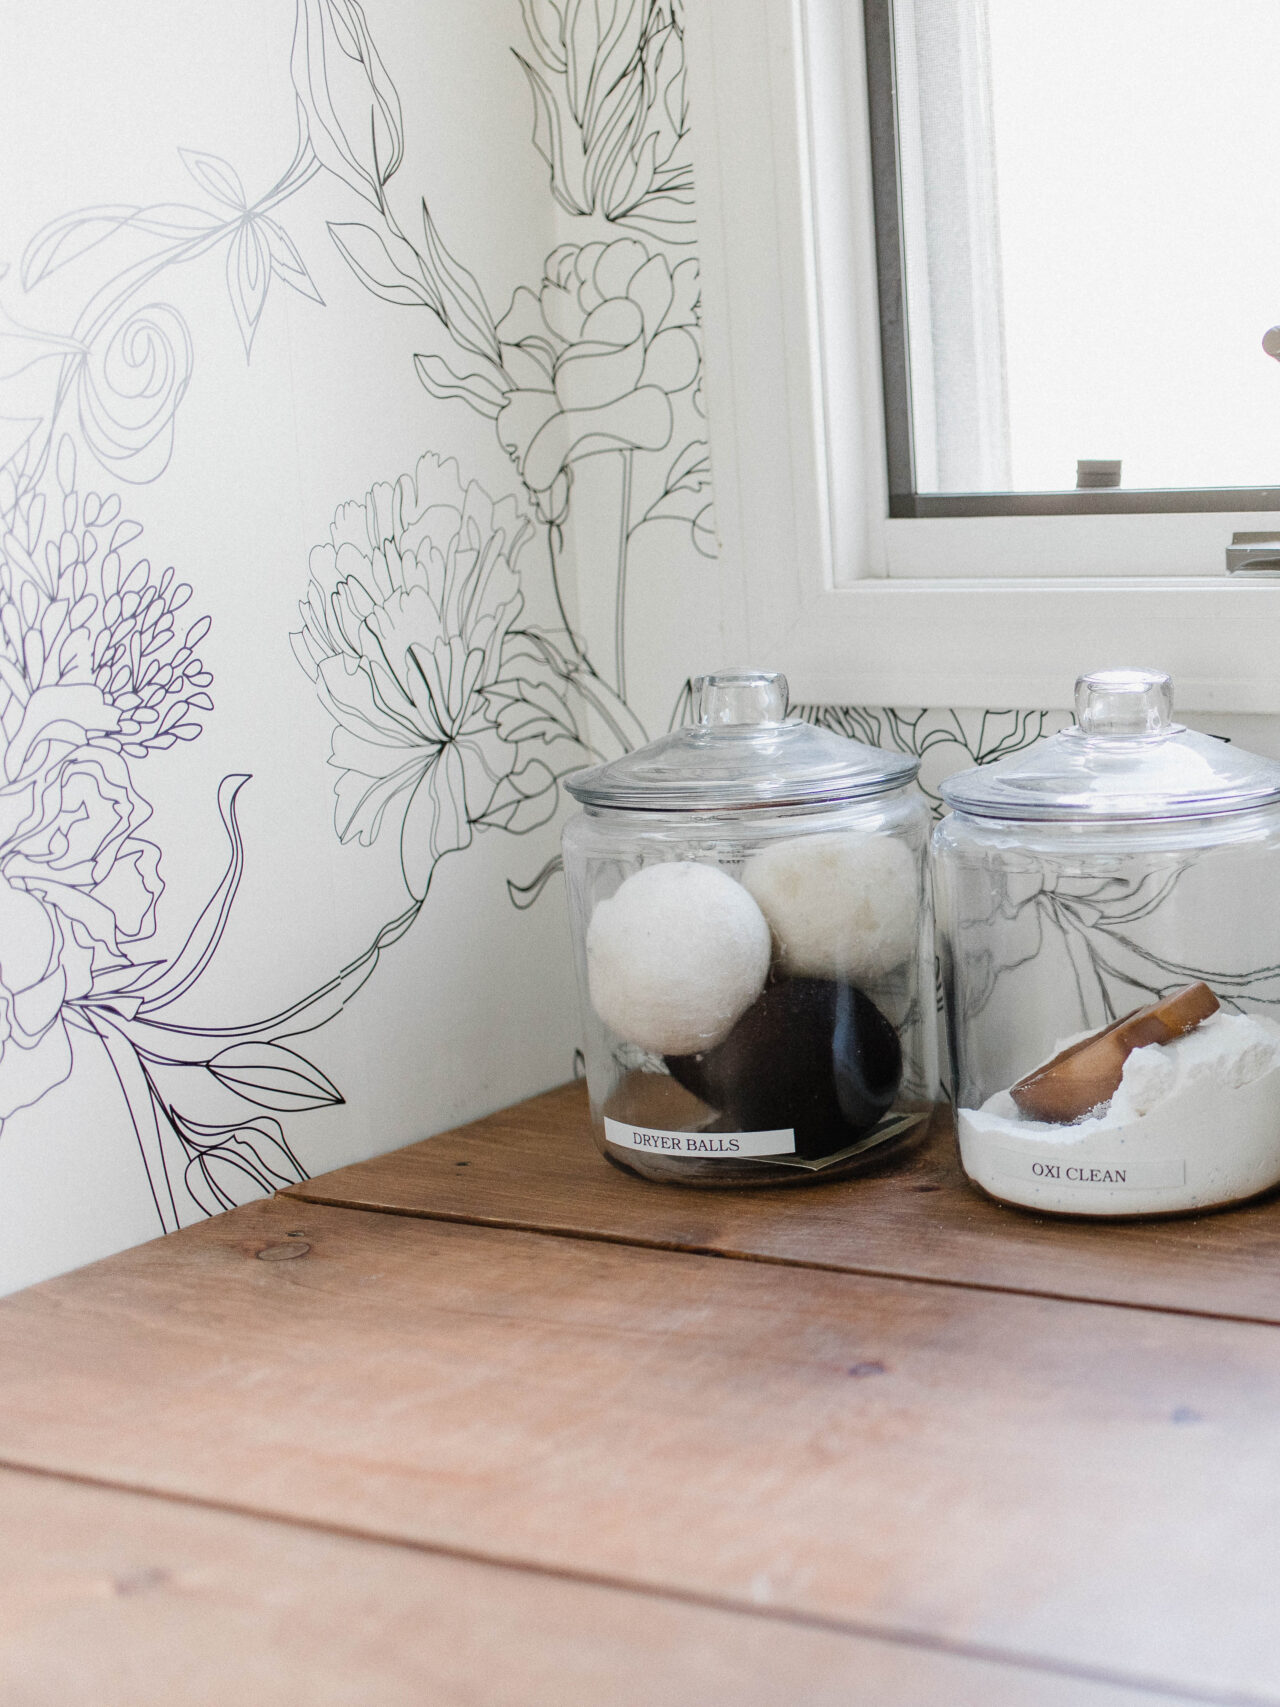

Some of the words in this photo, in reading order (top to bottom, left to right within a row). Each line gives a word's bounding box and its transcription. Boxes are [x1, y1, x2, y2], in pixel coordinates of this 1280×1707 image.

[633, 1132, 682, 1151] DRYER
[686, 1138, 740, 1152] BALLS
[1032, 1162, 1061, 1179] OXI
[1066, 1167, 1127, 1183] CLEAN
